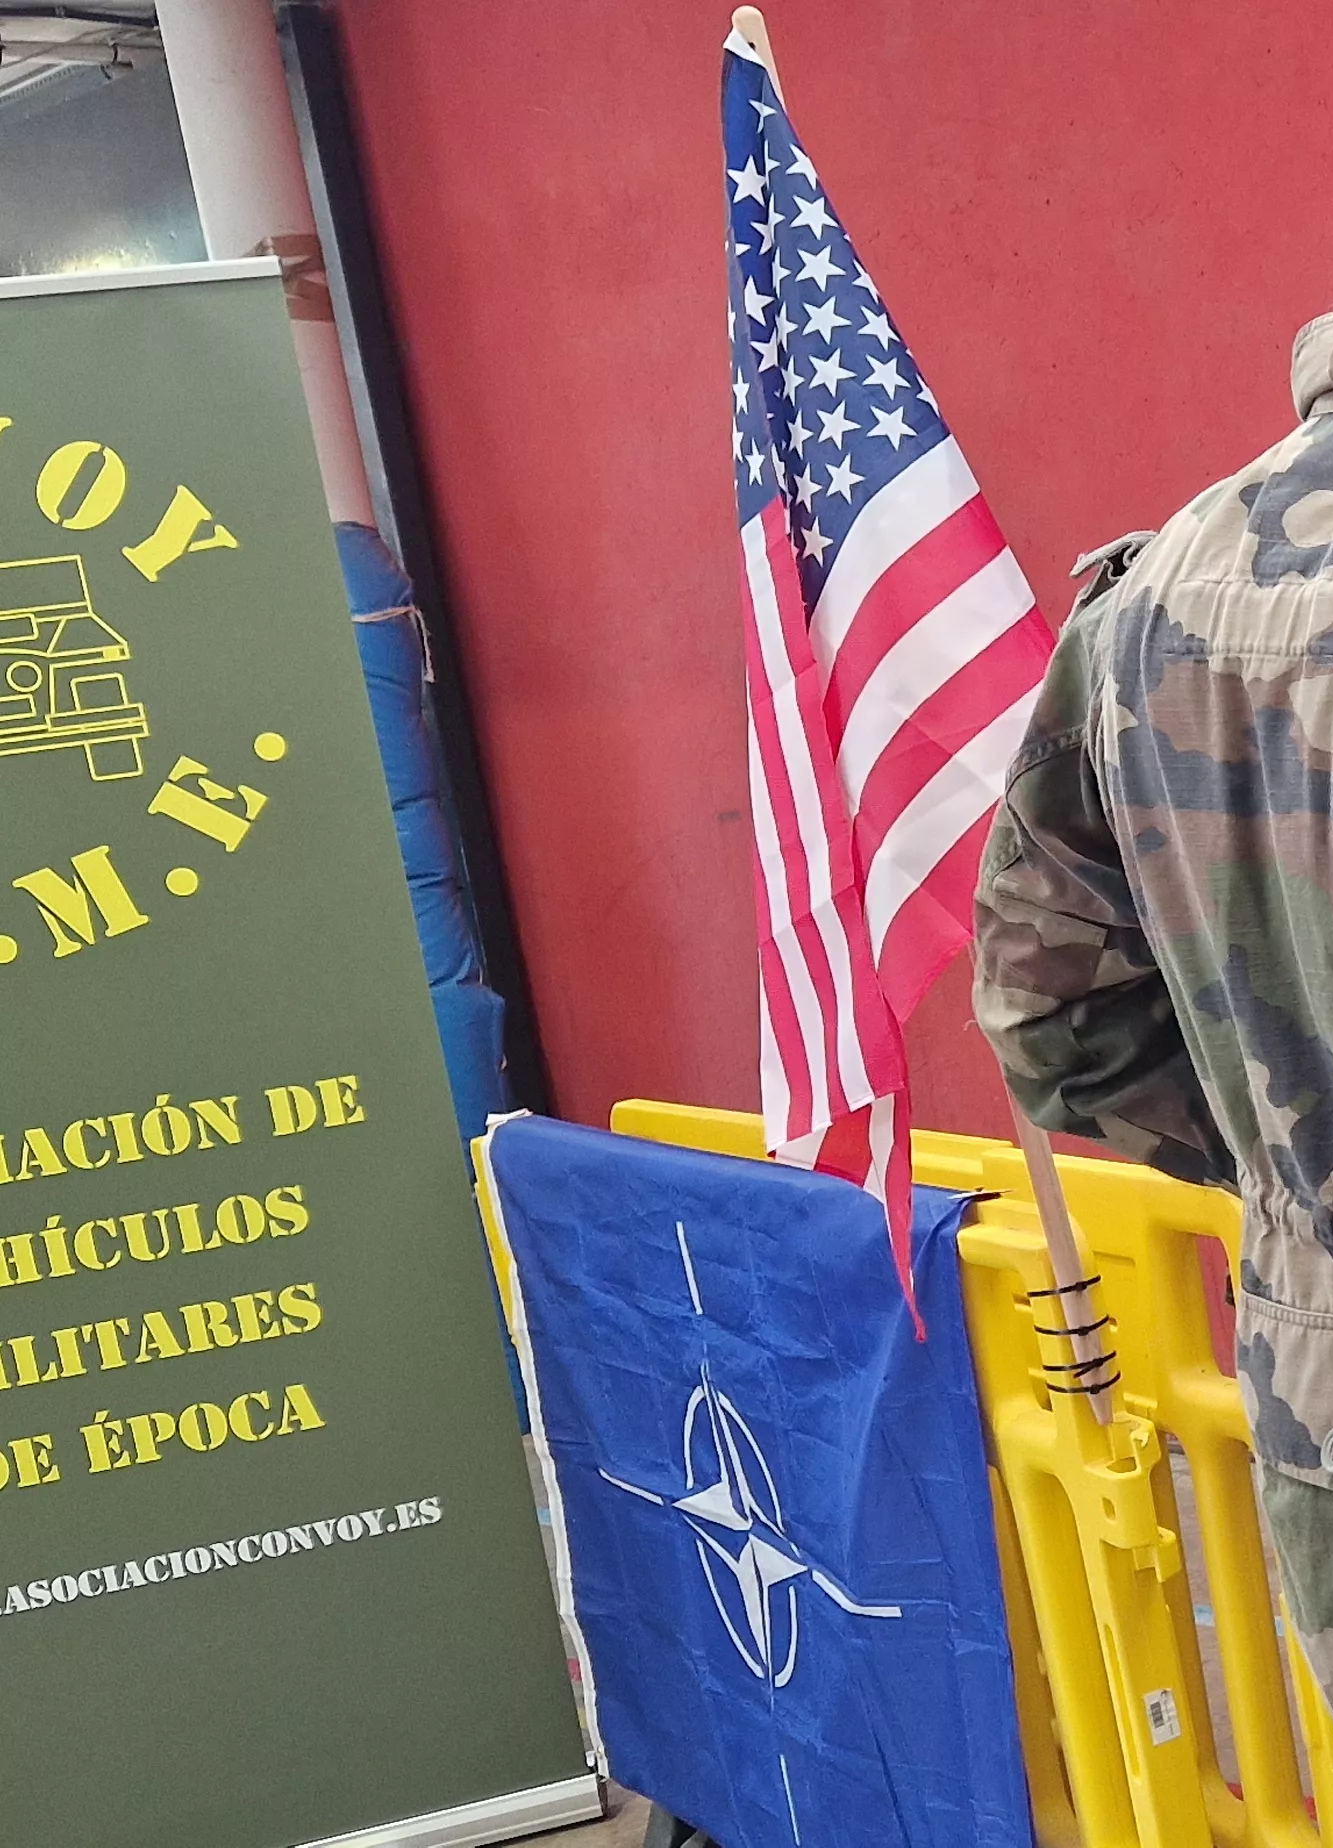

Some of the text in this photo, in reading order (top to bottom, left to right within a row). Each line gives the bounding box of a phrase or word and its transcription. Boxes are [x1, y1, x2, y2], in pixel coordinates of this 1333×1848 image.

[0, 416, 239, 583] OY
[263, 1074, 366, 1137] DE
[79, 1382, 328, 1474] ÉPOCA
